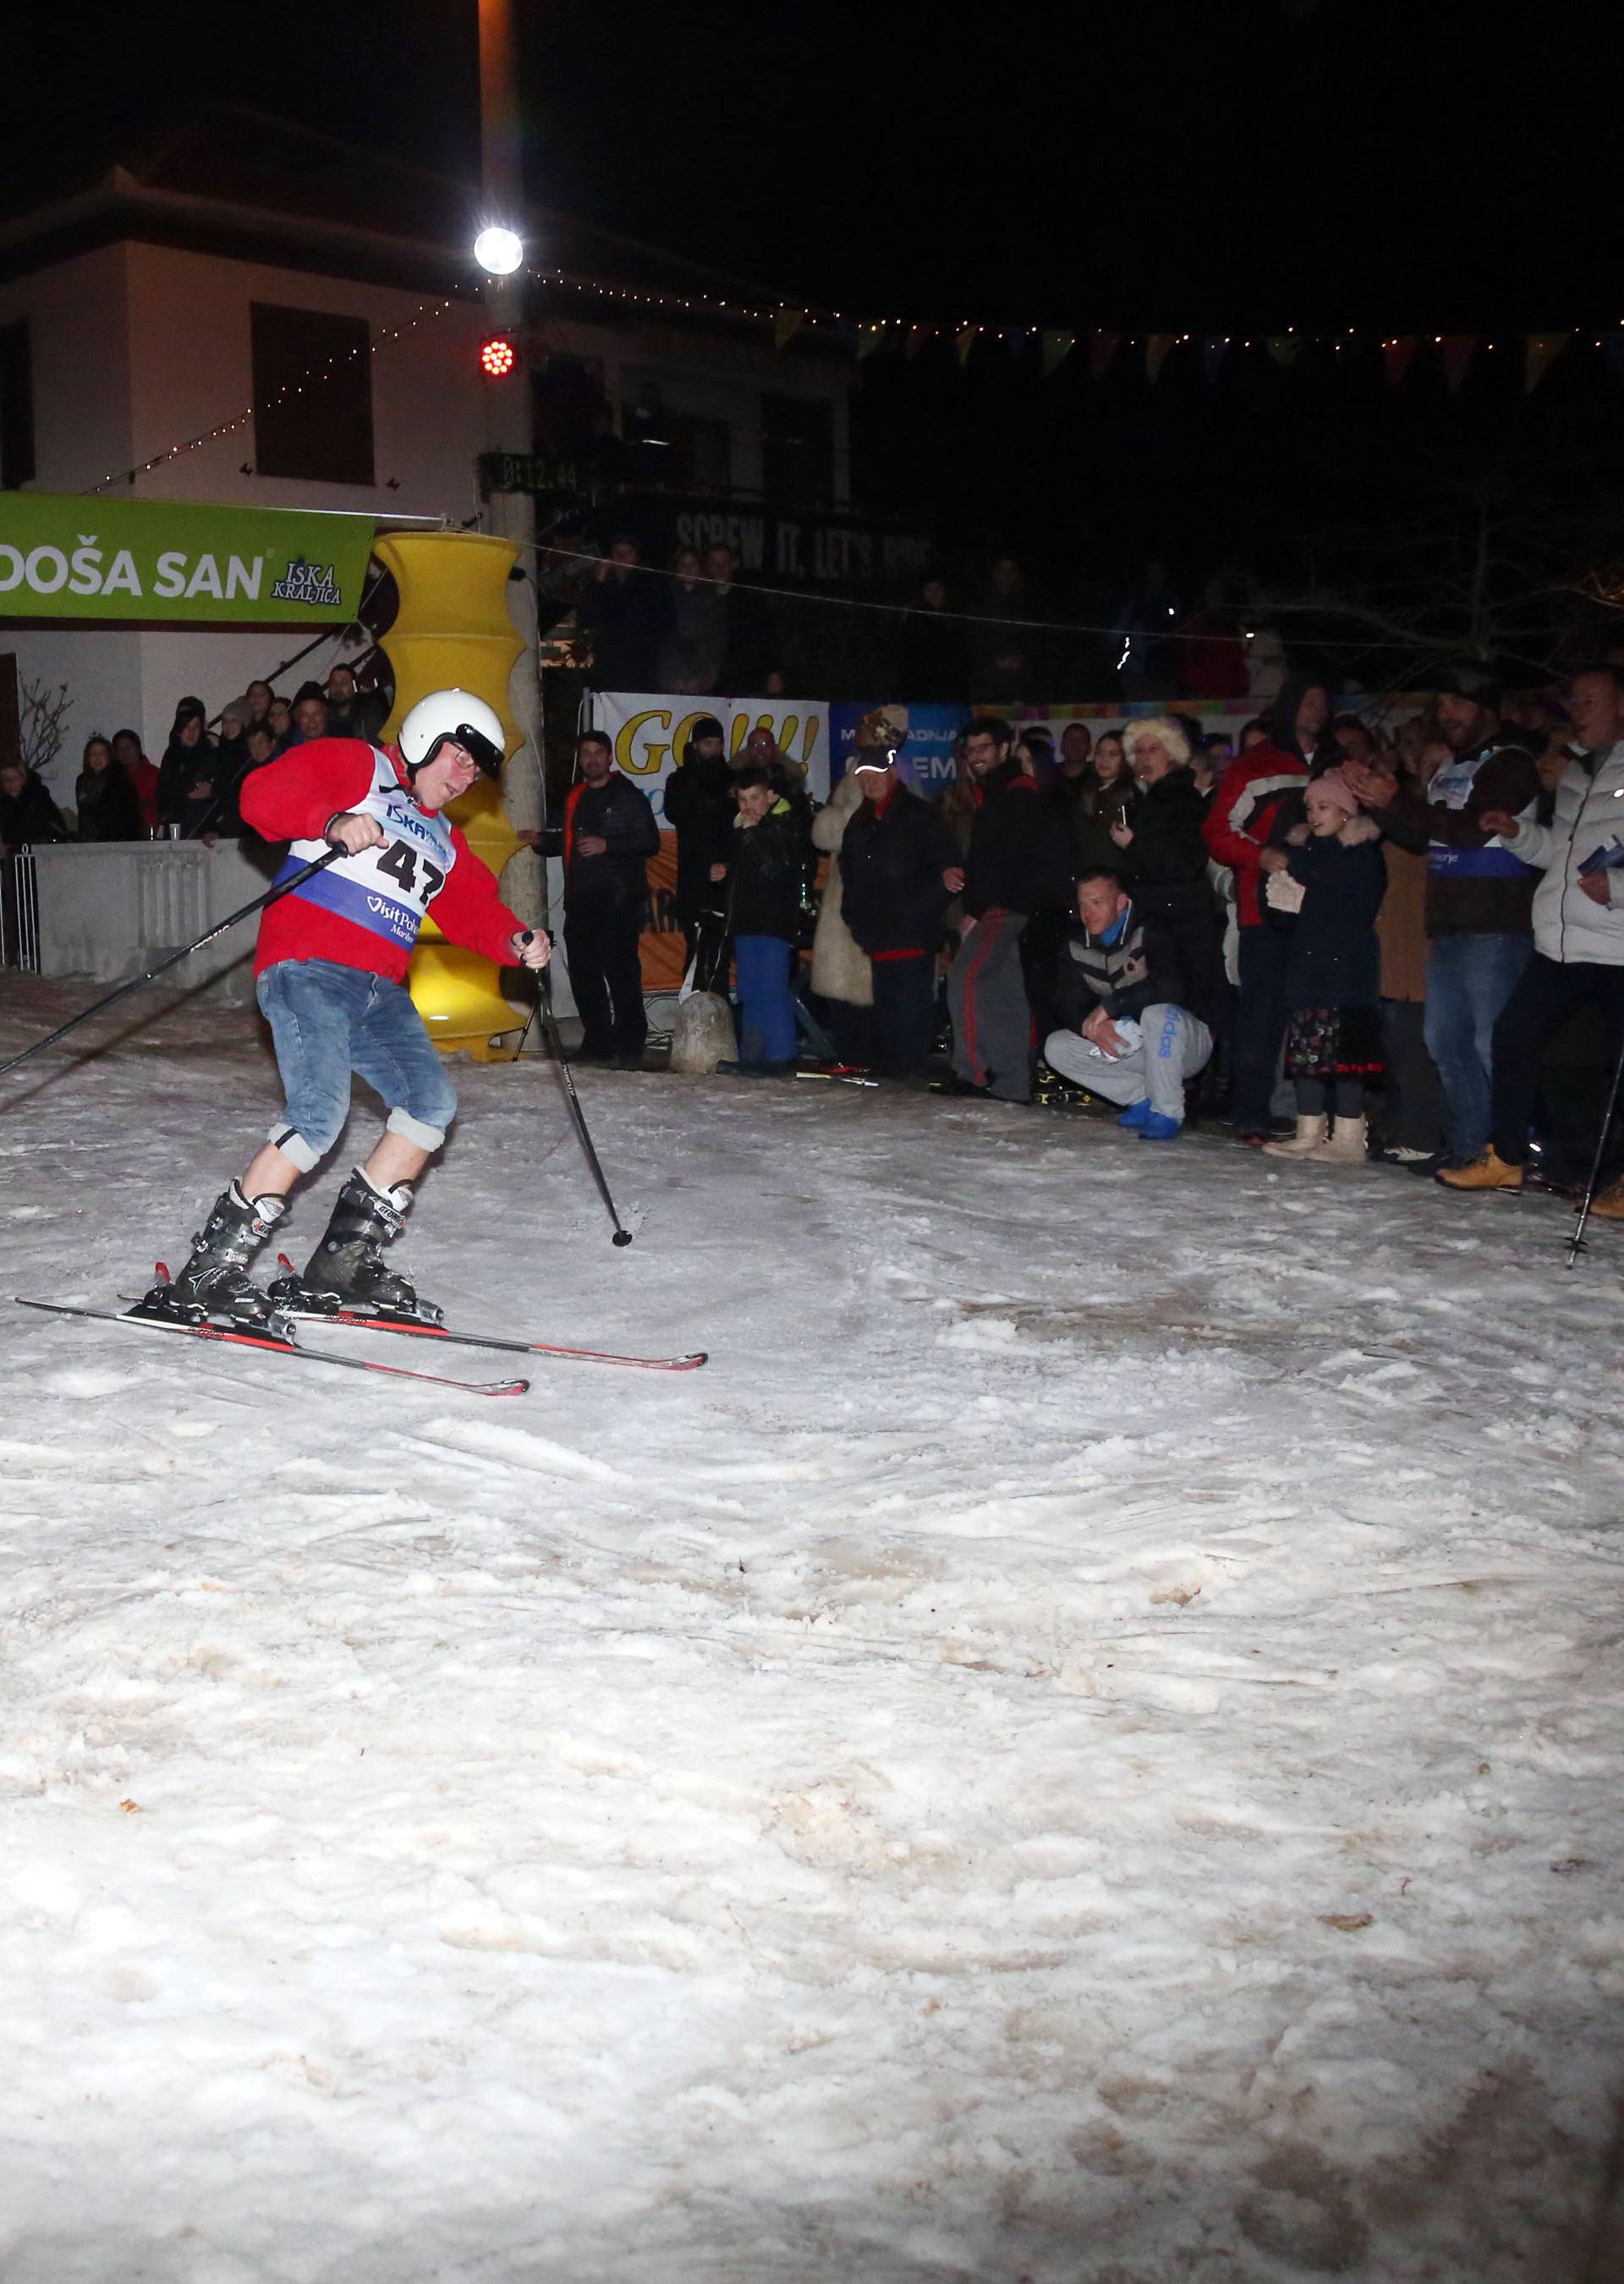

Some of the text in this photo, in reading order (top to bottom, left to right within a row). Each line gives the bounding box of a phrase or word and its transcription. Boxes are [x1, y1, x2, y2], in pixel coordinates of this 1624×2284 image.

[154, 552, 265, 600] SAN
[272, 581, 340, 604] KRALJICA
[284, 563, 333, 588] ISKA
[377, 839, 444, 906] 47
